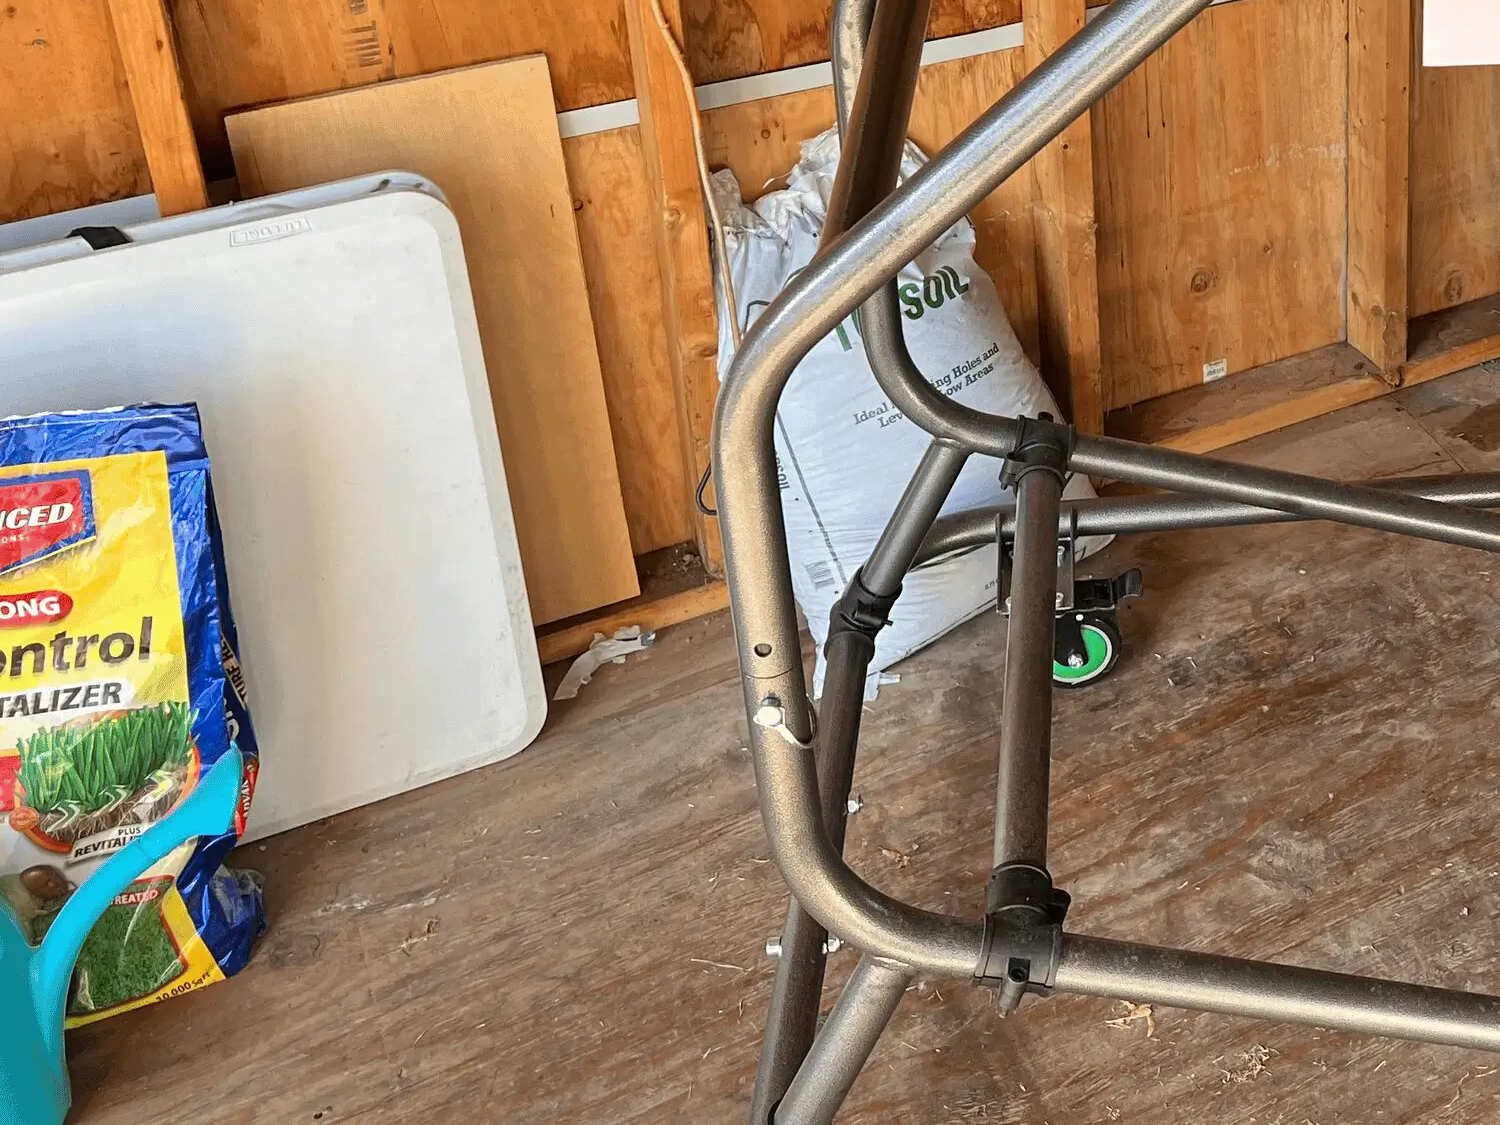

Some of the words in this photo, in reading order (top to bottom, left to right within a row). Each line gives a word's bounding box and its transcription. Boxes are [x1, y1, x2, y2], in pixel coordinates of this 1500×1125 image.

[852, 402, 889, 425] Ideal
[951, 356, 982, 381] Holes
[982, 342, 1000, 362] and
[964, 362, 995, 388] Areas
[0, 501, 74, 531] CED
[118, 825, 141, 836] PLUS
